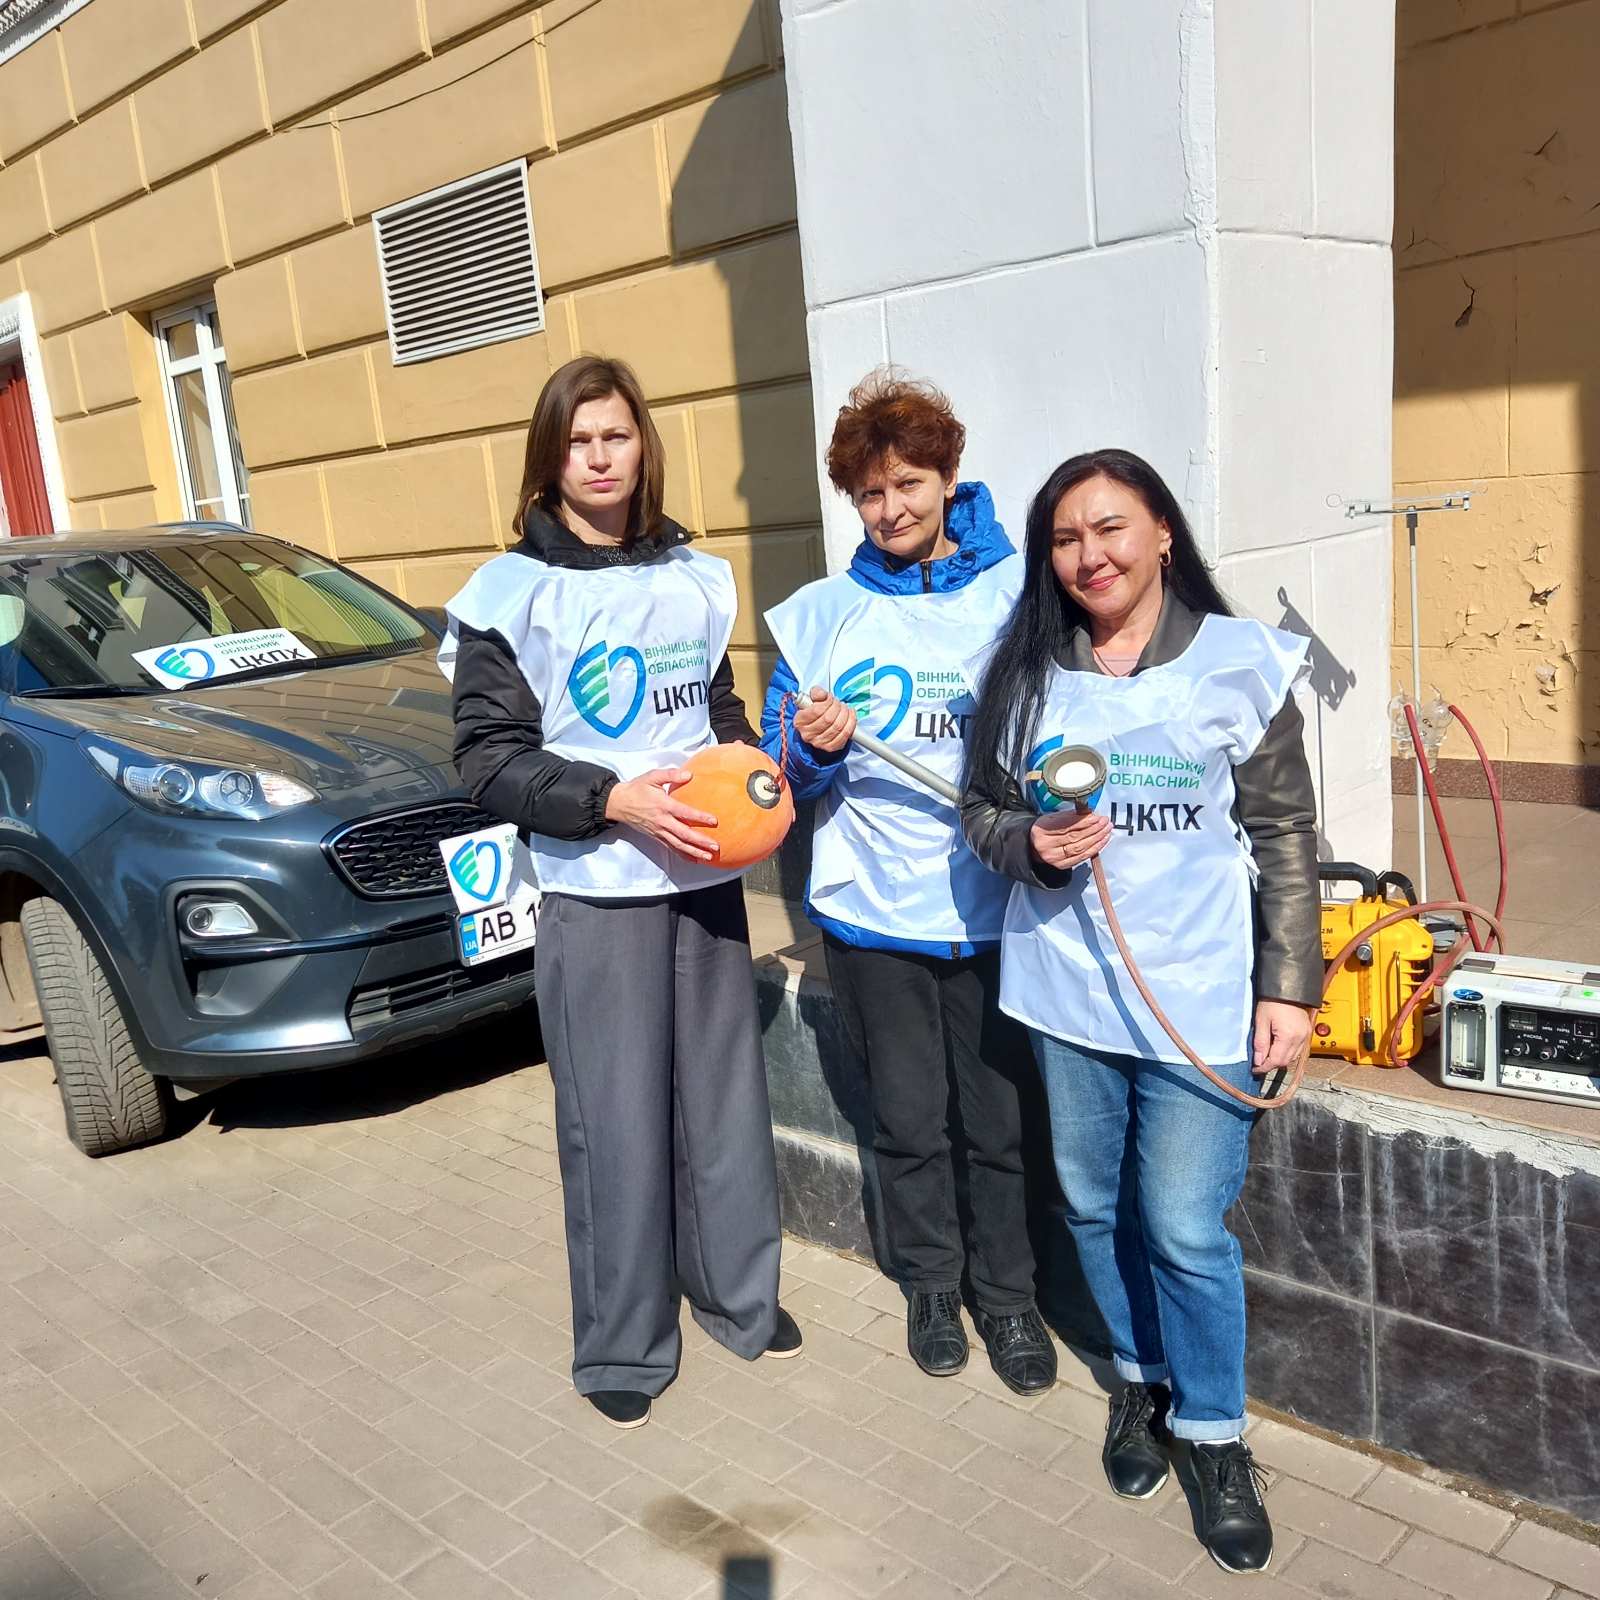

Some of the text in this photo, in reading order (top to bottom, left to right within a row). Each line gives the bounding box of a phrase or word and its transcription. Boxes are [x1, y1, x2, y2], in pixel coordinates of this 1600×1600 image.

[221, 640, 280, 655] ОБЛАСНИЙ
[229, 648, 306, 669] ЦКПХ
[648, 653, 705, 675] ОБЛАСНИЙ
[917, 671, 965, 684] ВІННИ
[653, 680, 710, 717] ЦКПХ
[1110, 753, 1206, 777] ВІННИЦЬКИЙ
[1110, 772, 1200, 790] ОБЛАСНИЙ
[1110, 802, 1205, 836] ЦКПХ
[481, 900, 541, 946] AB 1
[465, 940, 477, 951] UA
